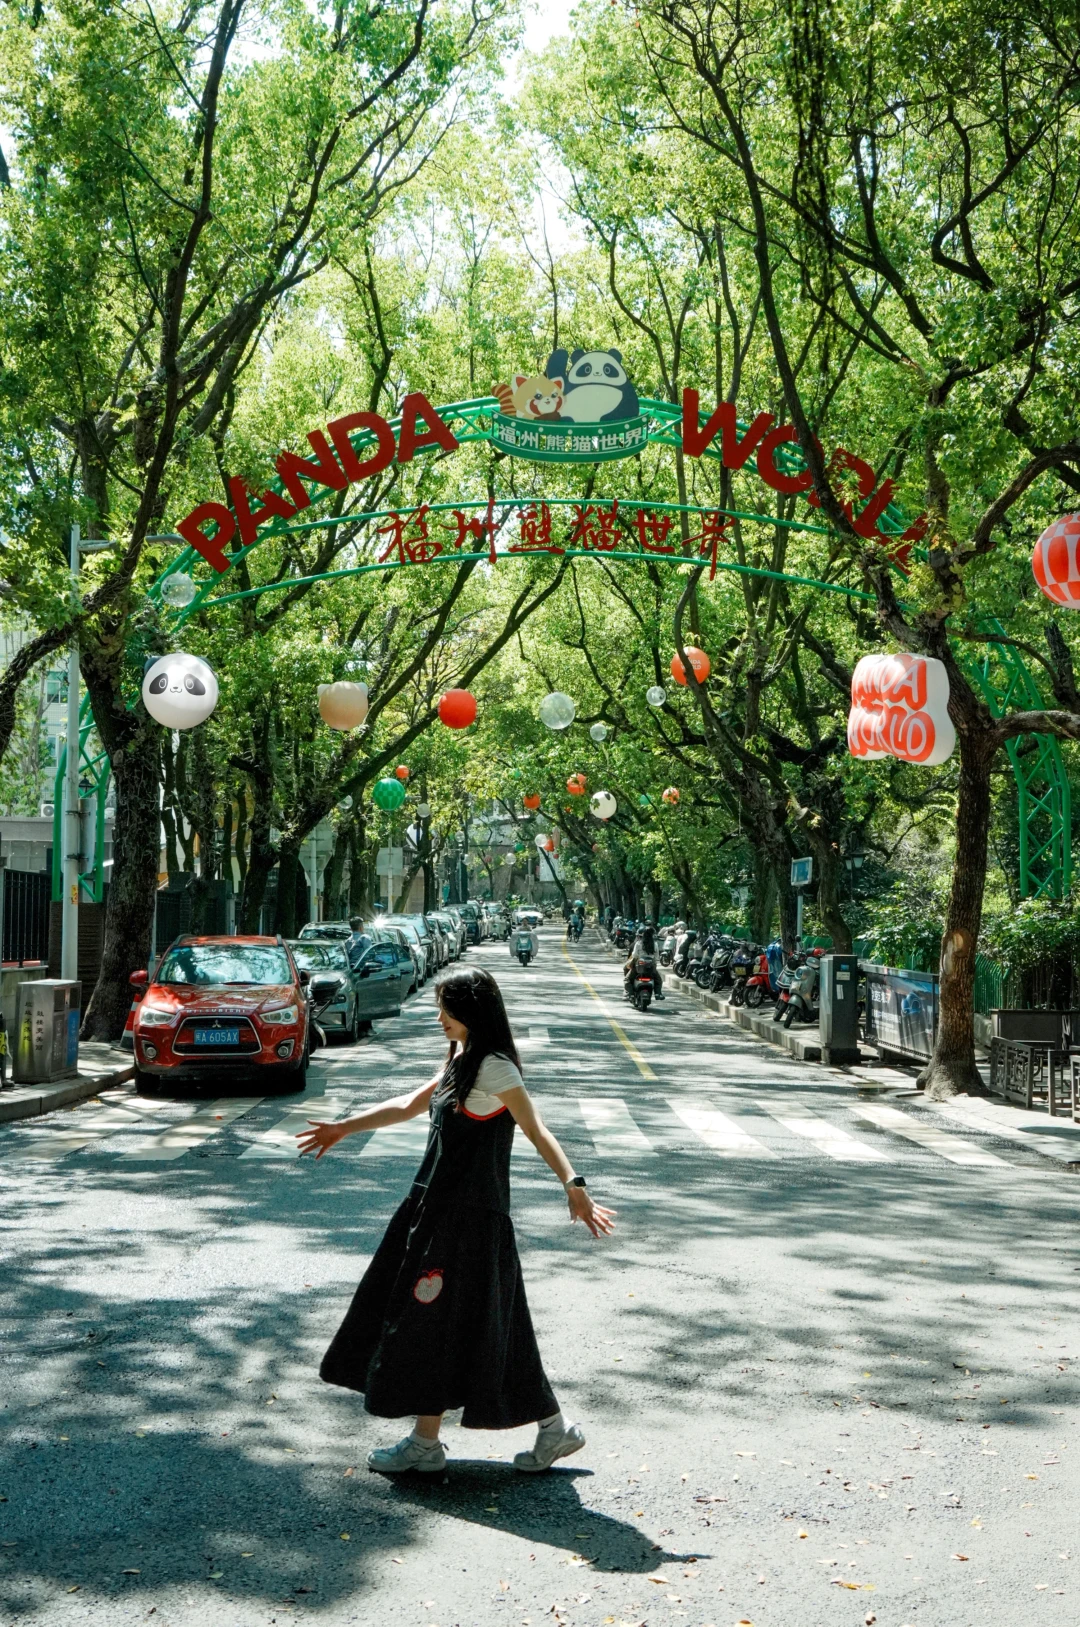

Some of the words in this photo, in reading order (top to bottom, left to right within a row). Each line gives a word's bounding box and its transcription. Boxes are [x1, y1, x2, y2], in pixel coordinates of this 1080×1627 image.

[498, 424, 643, 452] 福州熊猫世界
[177, 392, 459, 574] PANDA
[377, 496, 736, 581] 福州熊猫世界
